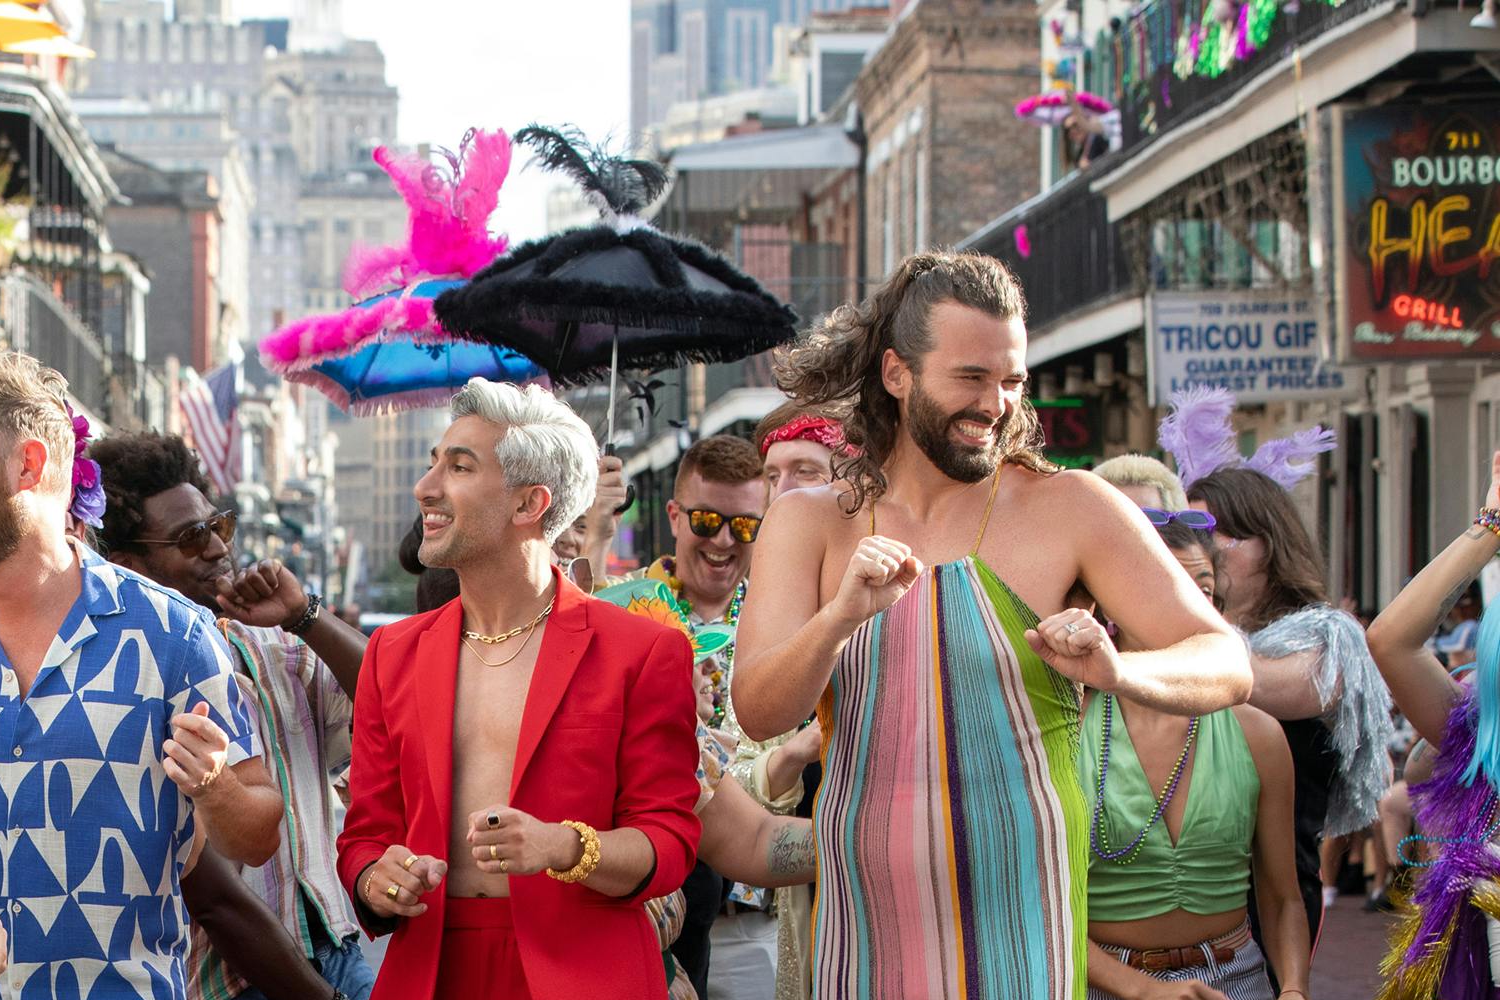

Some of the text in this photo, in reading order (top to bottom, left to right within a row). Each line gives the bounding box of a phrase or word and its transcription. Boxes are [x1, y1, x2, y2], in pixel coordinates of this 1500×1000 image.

[1446, 132, 1480, 150] 711
[1393, 154, 1500, 188] BOURB
[1393, 295, 1463, 328] GRILL
[1160, 322, 1262, 351] TRICOU
[1186, 357, 1318, 374] GUARANTEE
[1267, 373, 1344, 388] PRICES
